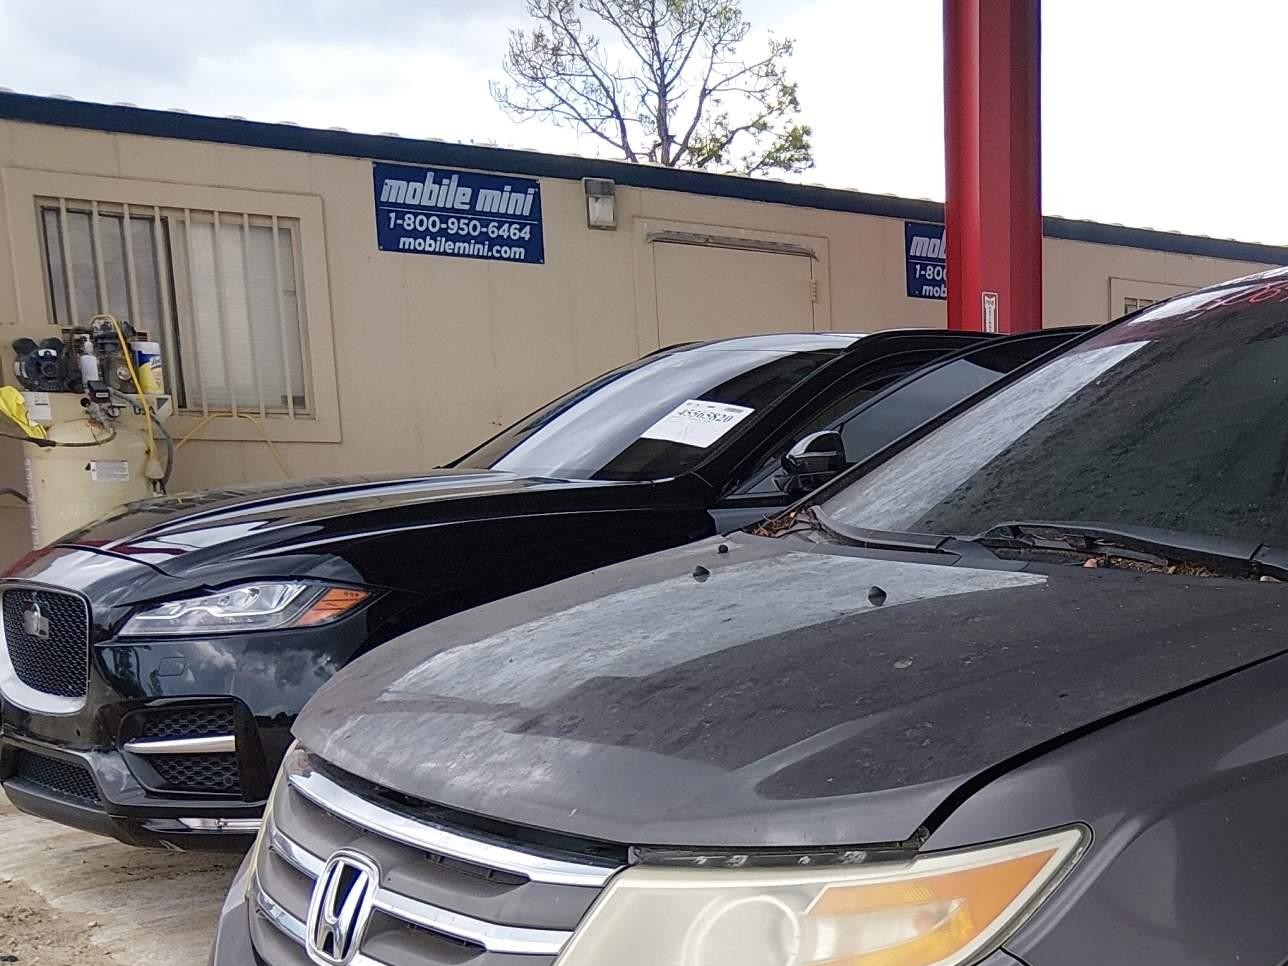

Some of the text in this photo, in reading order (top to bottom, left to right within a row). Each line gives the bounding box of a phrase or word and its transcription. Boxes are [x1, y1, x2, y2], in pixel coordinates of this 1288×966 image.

[380, 171, 535, 216] mobile mini
[389, 212, 531, 241] 1-800-950-6464
[399, 235, 525, 260] mobilemini.com
